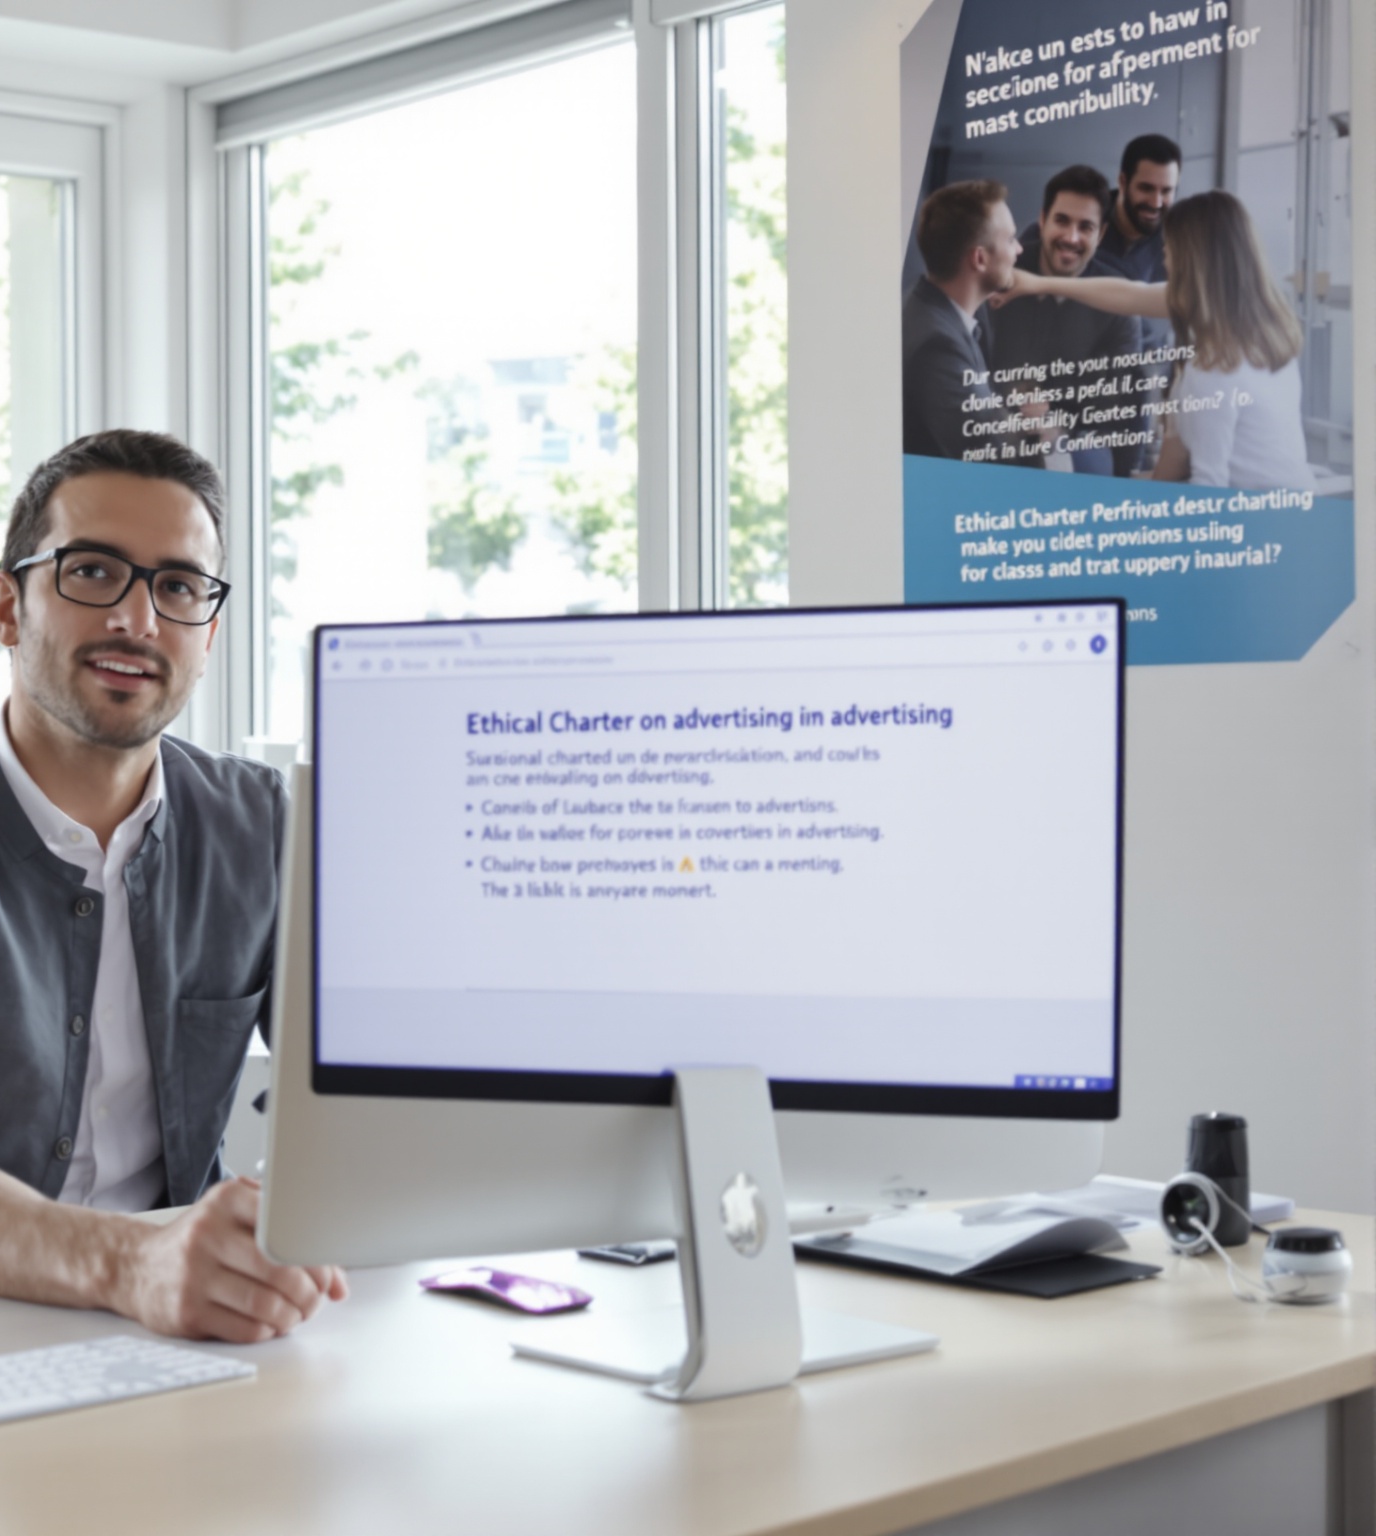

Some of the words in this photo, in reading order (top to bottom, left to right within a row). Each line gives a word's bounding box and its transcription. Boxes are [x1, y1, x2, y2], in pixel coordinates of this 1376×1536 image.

[1038, 40, 1065, 61] un
[1071, 27, 1116, 53] ests
[1120, 22, 1144, 42] to
[1149, 8, 1200, 36] haw
[1206, 0, 1228, 22] in
[1064, 61, 1095, 86] for
[1099, 33, 1223, 79] afperment
[1226, 25, 1261, 50] for
[965, 109, 1019, 139] mast
[1050, 358, 1076, 377] the
[1065, 386, 1075, 400] a
[954, 509, 1016, 534] Ethical
[1019, 507, 1088, 528] Charter
[960, 536, 1009, 557] make
[1012, 537, 1046, 558] you
[960, 563, 988, 583] for
[1048, 556, 1081, 577] and
[1085, 556, 1121, 576] trat
[1124, 554, 1191, 577] uppery
[466, 710, 542, 735] Ethical
[549, 709, 633, 733] Charter
[639, 713, 666, 731] on
[673, 706, 793, 732] advertising
[830, 703, 952, 729] advertising
[793, 746, 823, 762] and
[602, 771, 623, 785] on
[541, 798, 559, 815] of
[628, 798, 653, 815] the
[735, 799, 752, 814] to
[589, 822, 613, 841] for
[482, 881, 509, 898] The
